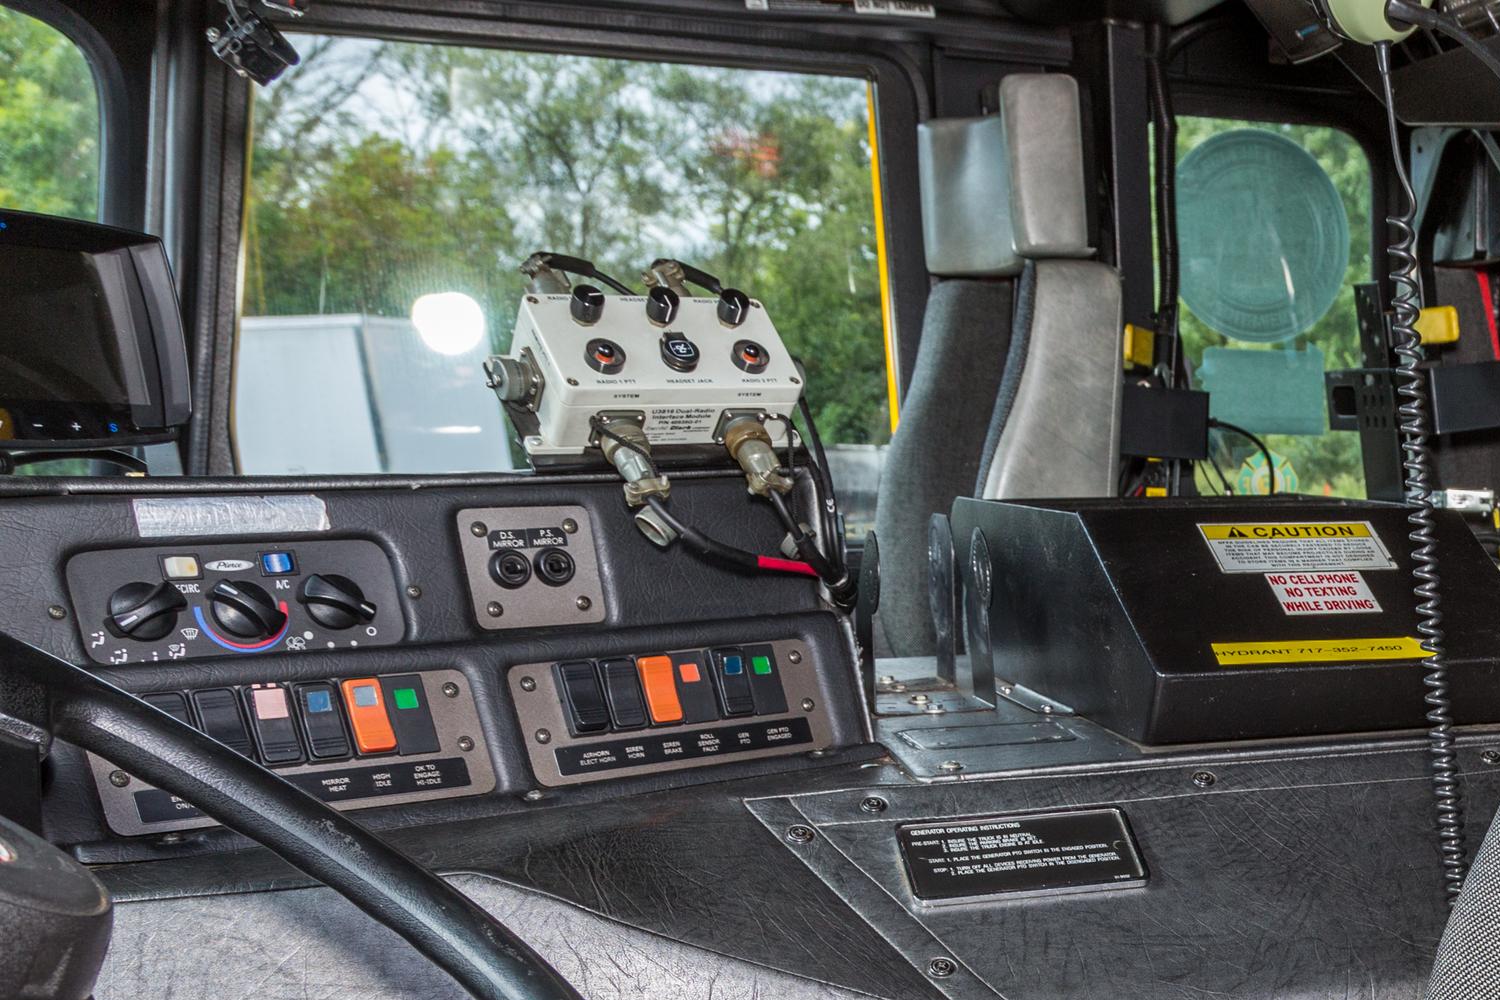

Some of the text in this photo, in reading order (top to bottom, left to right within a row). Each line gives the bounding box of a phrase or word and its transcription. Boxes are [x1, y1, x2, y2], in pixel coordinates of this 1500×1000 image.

[540, 529, 554, 537] P.S.
[1252, 526, 1354, 537] CAUTION
[492, 539, 525, 548] MIRROR
[533, 537, 564, 546] MIRROR
[1268, 574, 1360, 585] NO CELLPHONE
[276, 580, 290, 590] A/C
[1284, 586, 1358, 598] NO TEXTING
[1282, 599, 1374, 613] WHILE DRIVING
[1215, 648, 1296, 657] HYDRANT
[698, 739, 720, 747] SENSOR
[583, 750, 610, 759] AIRHORN
[664, 747, 683, 755] BRAKE
[580, 758, 598, 766] ELECT
[414, 771, 440, 779] ENGAGE
[321, 777, 350, 785] MIRROR
[910, 822, 1020, 836] GENERATOR OPERATING INSTRUCTIONS
